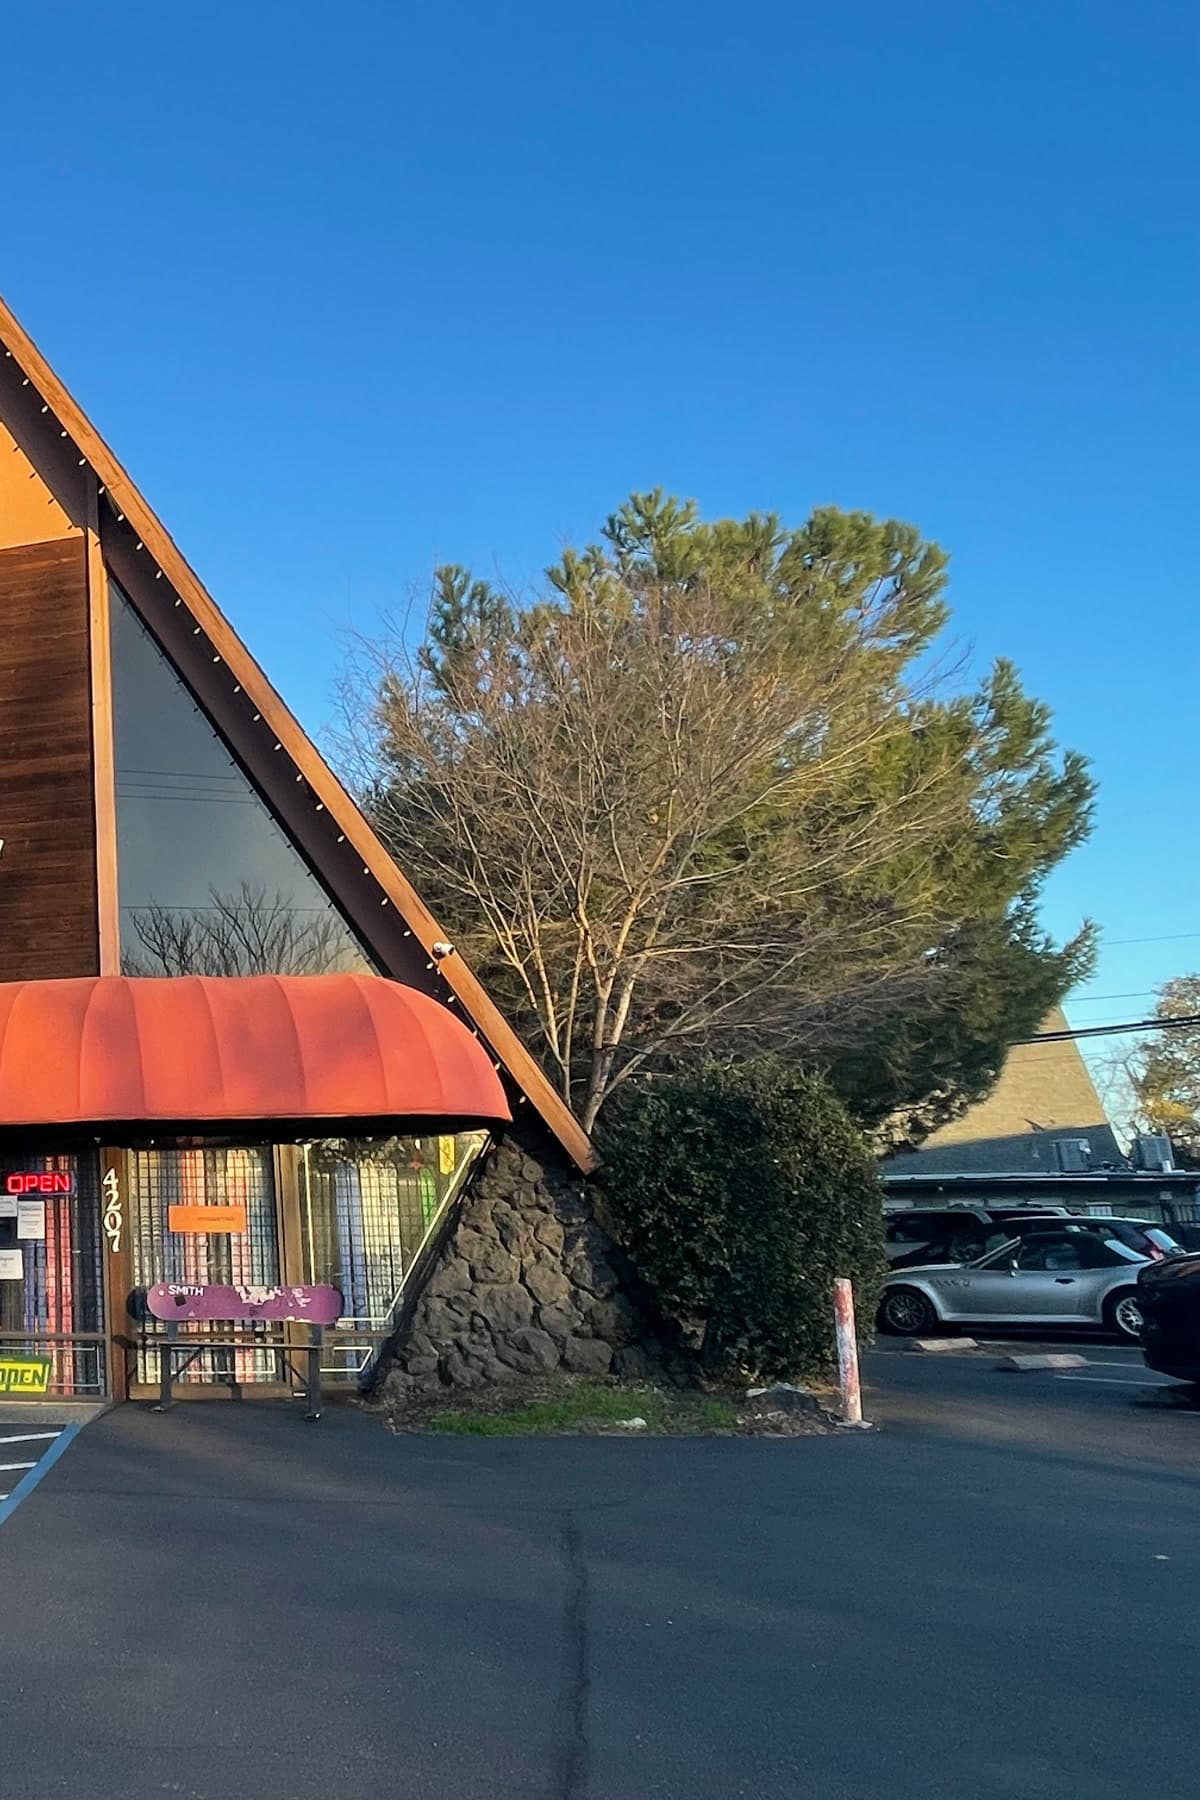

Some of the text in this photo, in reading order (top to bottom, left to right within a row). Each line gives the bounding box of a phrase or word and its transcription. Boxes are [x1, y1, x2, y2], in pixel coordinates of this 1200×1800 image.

[7, 1174, 70, 1193] OPEN
[102, 1167, 123, 1253] 4207
[168, 1284, 204, 1297] SMITH
